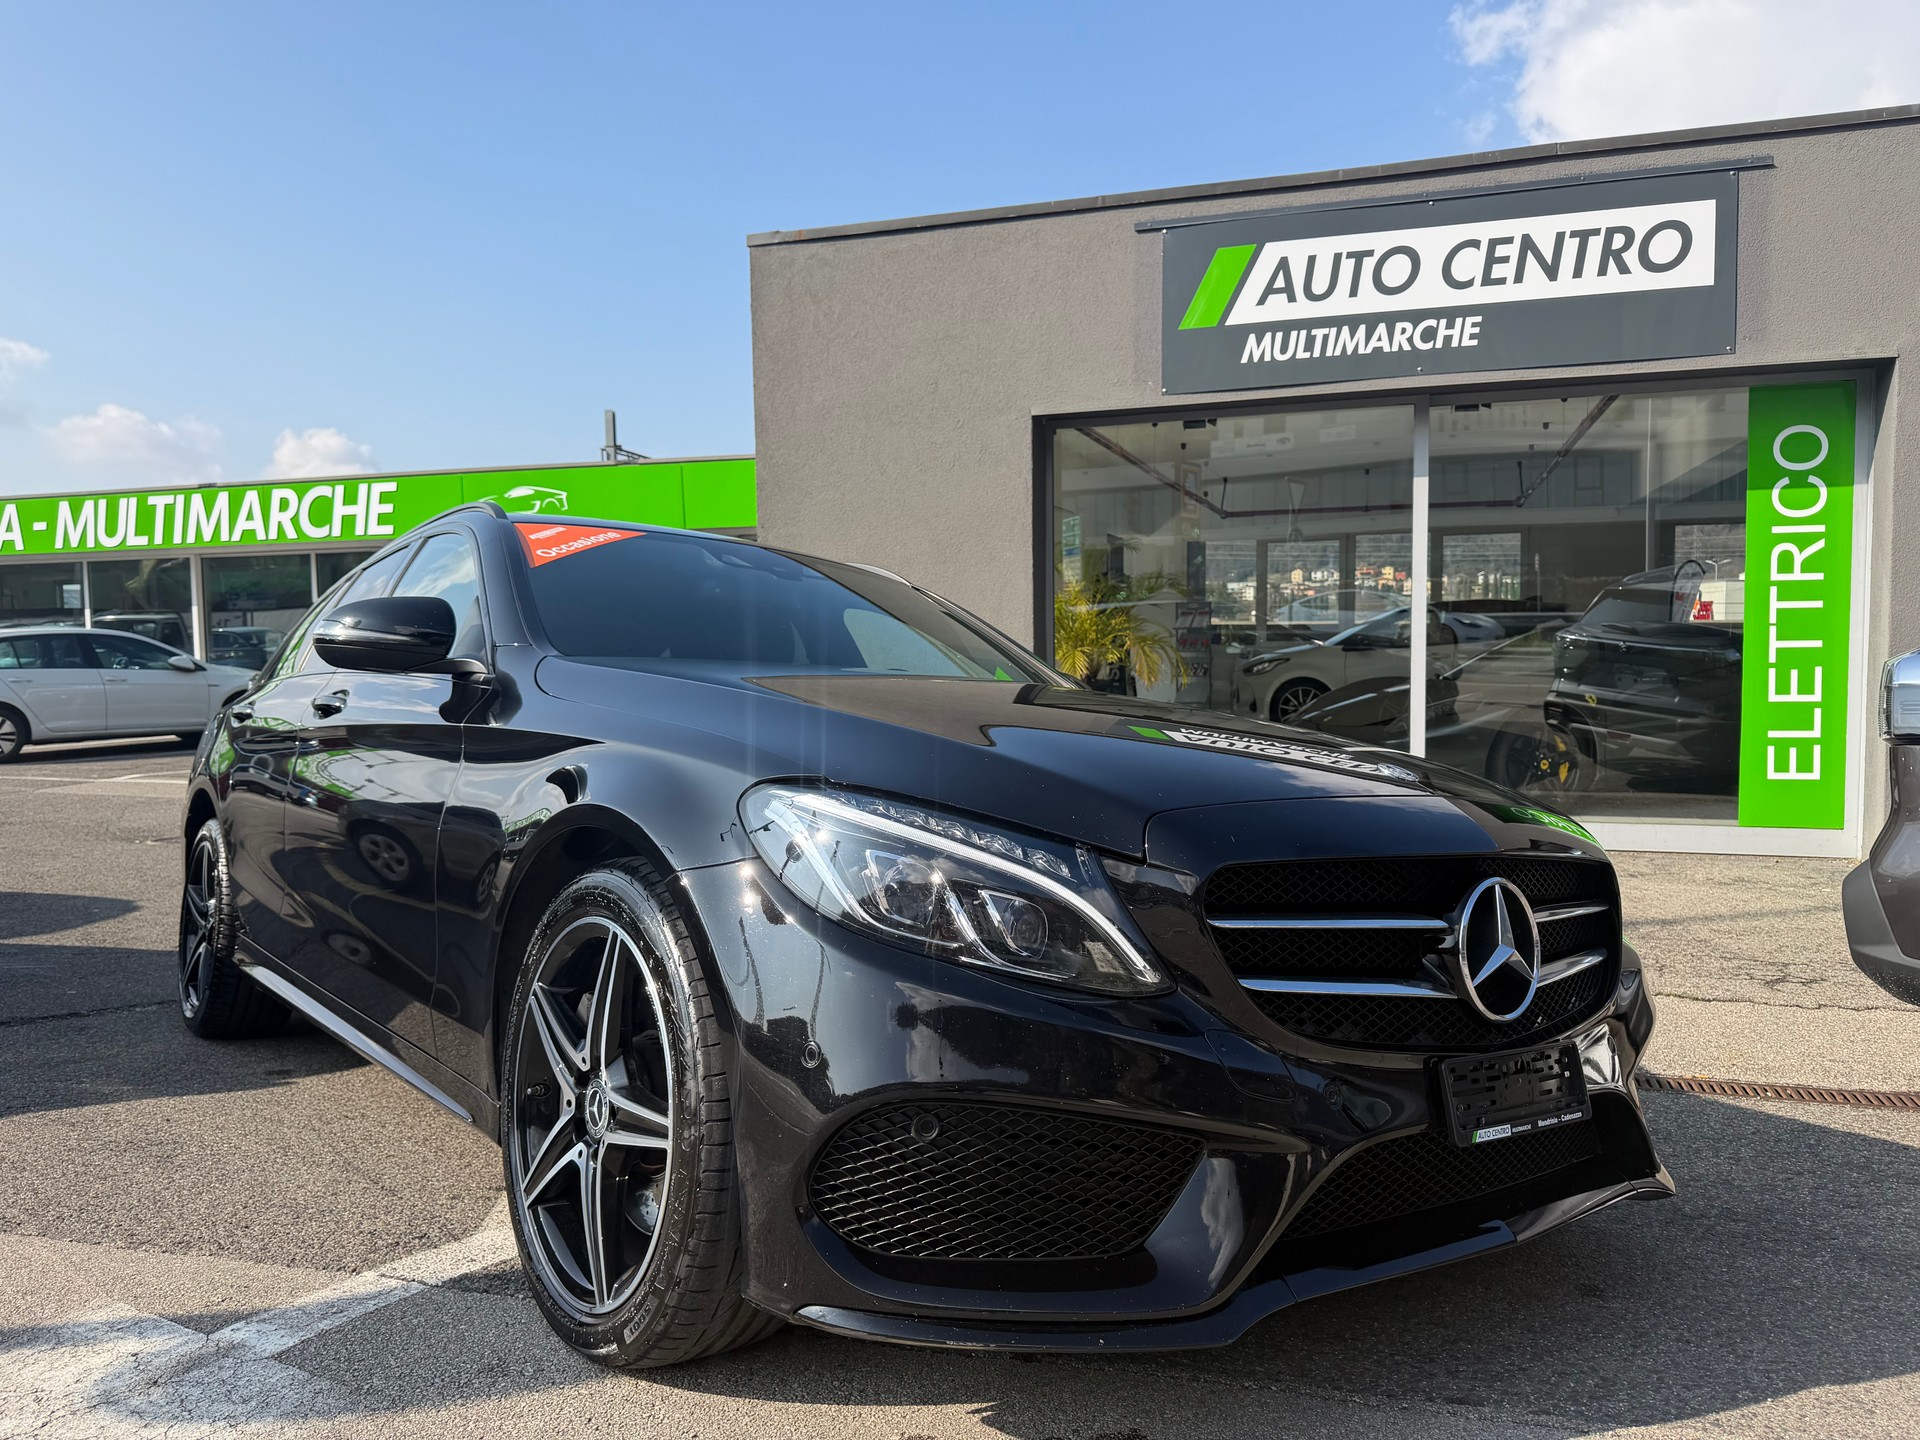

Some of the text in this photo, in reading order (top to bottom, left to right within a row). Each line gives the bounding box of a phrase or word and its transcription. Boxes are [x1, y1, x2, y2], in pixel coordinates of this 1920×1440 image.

[1255, 219, 1694, 307] AUTO CENTRO
[1240, 315, 1483, 364] MULTIMARCHE
[55, 481, 398, 549] MULTIMARCHE
[535, 531, 622, 557] Occasione
[1767, 424, 1829, 780] ELETTRICO
[1478, 1130, 1491, 1140] AUTO
[1491, 1126, 1510, 1137] CENTRO
